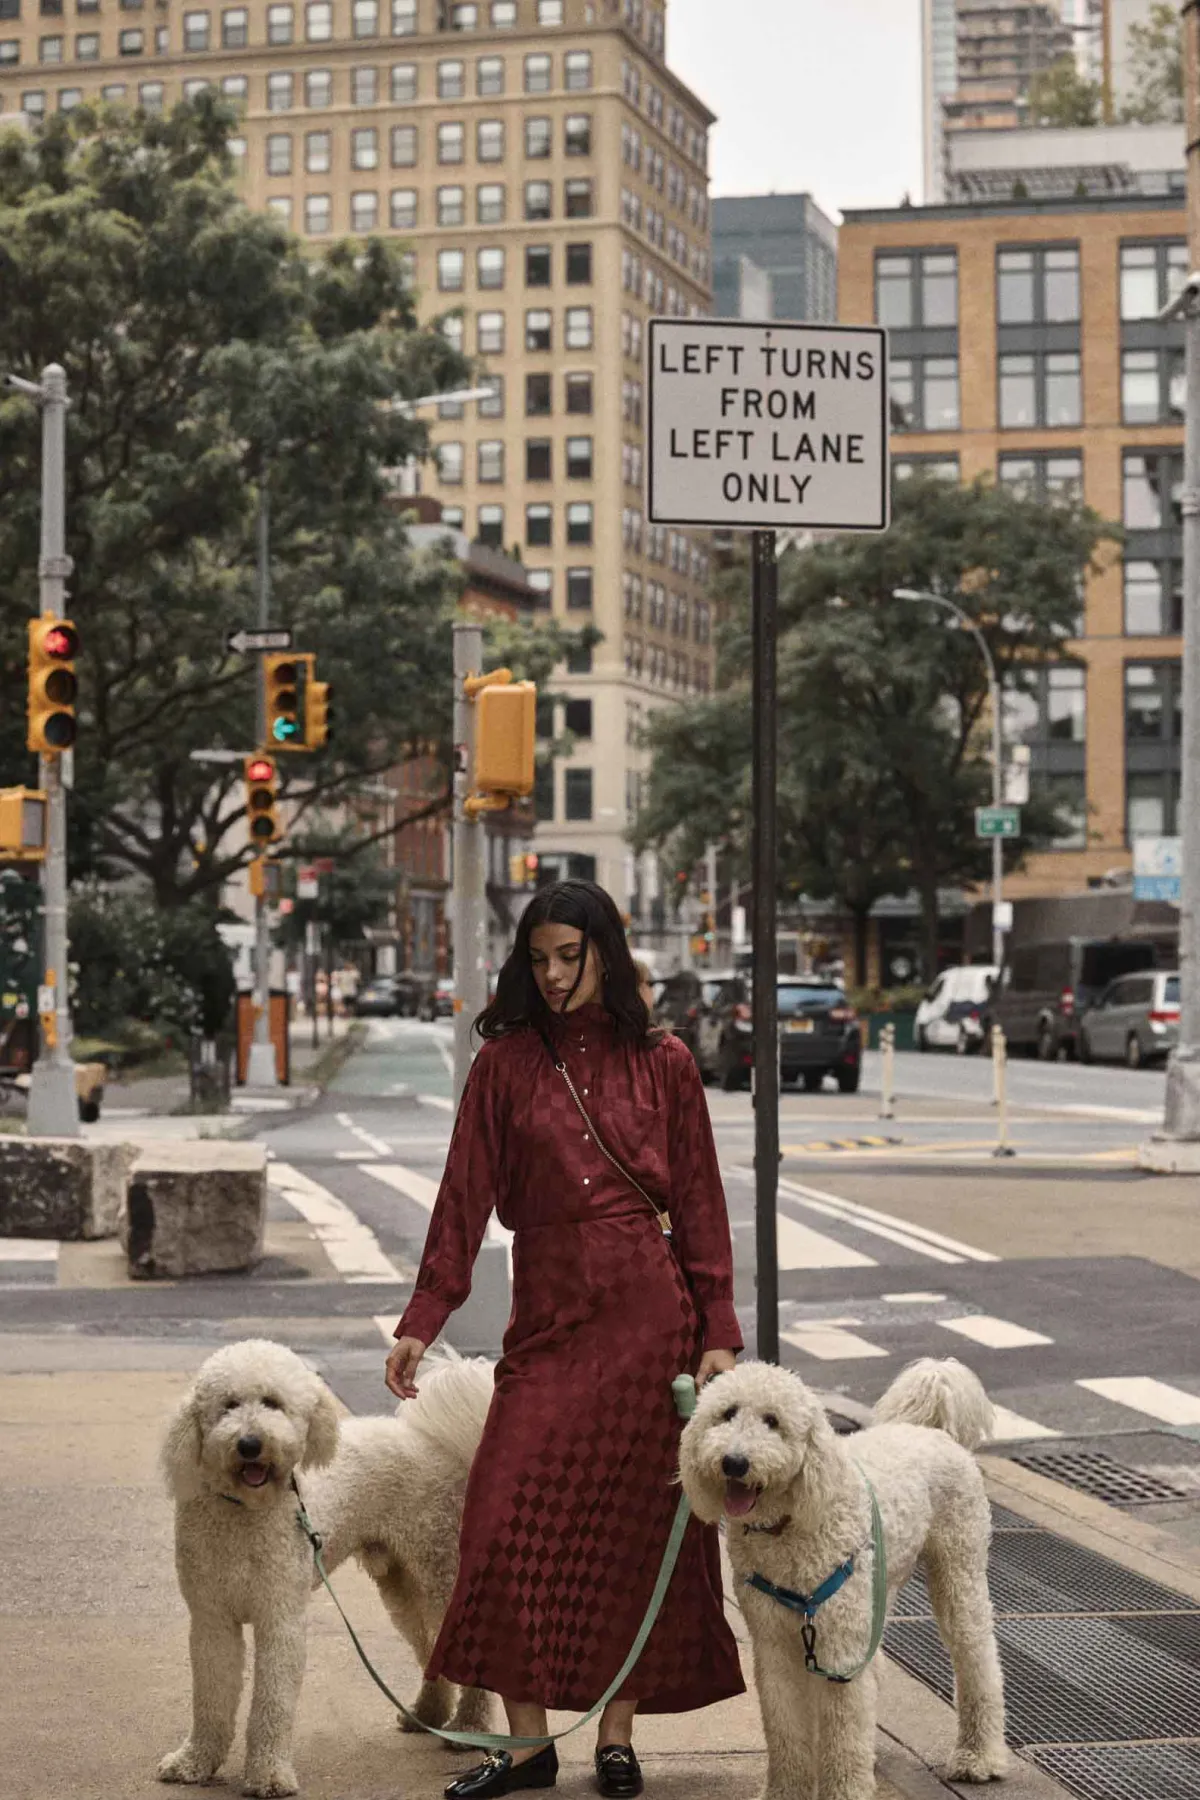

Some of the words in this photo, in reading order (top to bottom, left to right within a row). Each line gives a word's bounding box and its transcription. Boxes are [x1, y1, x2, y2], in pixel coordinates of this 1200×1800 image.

[660, 343, 745, 376] LEFT
[759, 346, 875, 380] TURNS
[721, 387, 816, 420] FROM
[670, 428, 755, 460] LEFT
[772, 431, 865, 464] LANE
[722, 472, 812, 504] ONLY
